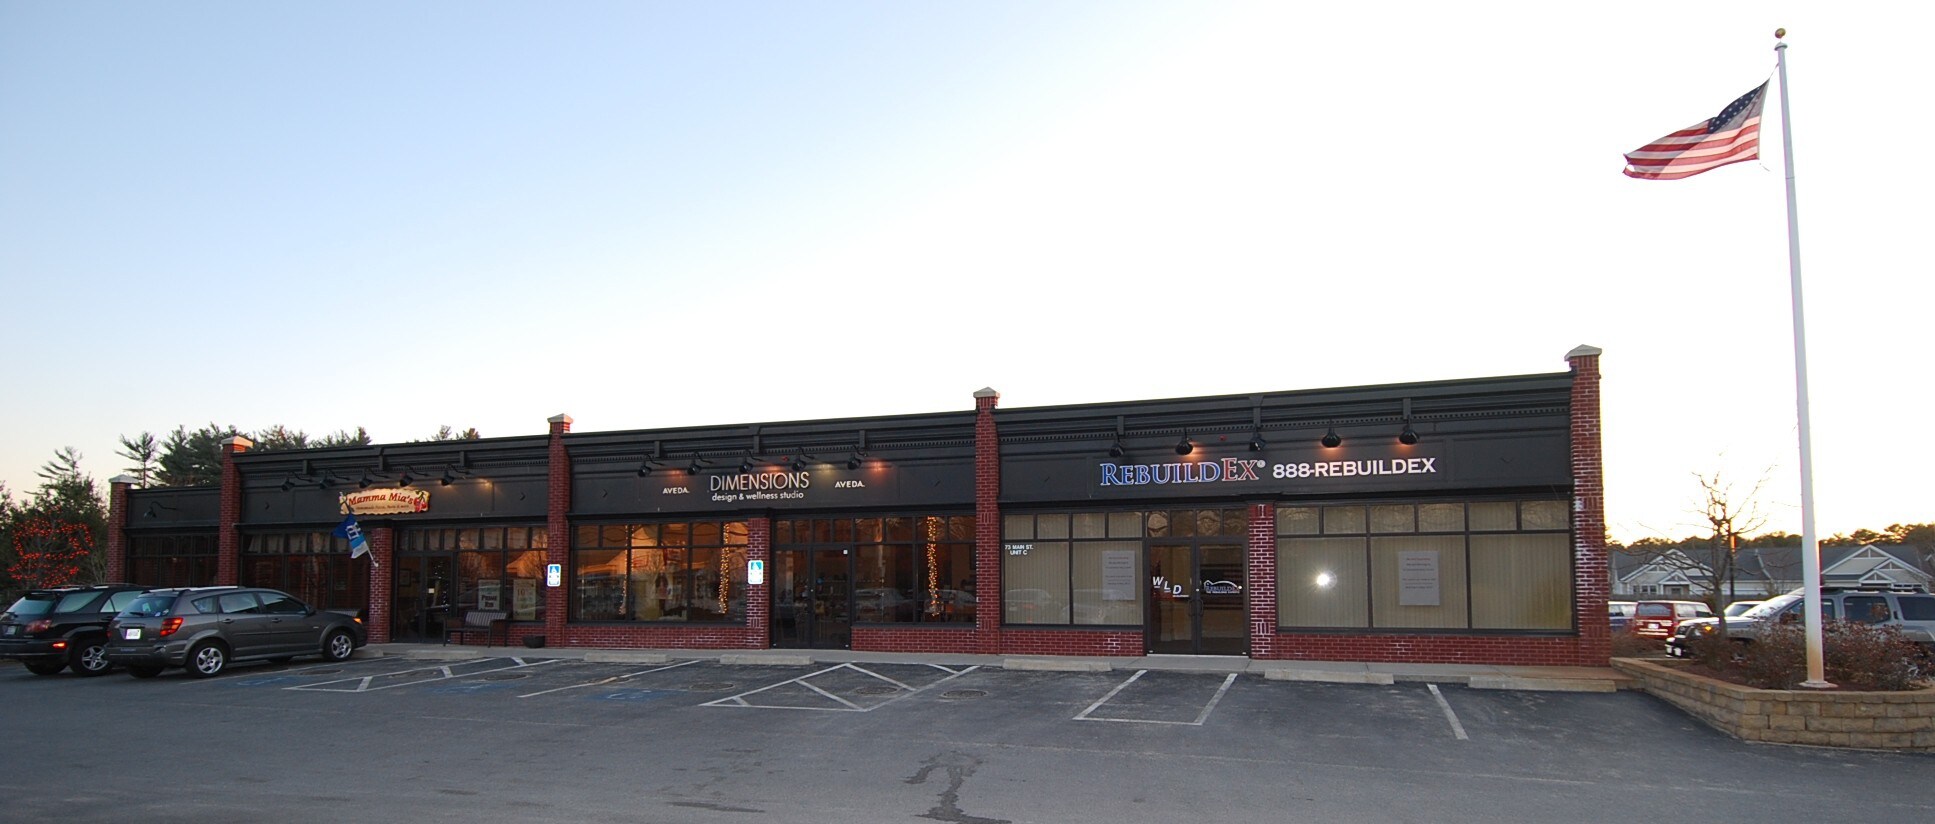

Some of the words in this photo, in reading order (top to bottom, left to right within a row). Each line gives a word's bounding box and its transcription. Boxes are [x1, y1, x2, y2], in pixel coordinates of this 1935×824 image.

[1272, 457, 1436, 479] 888-REBUILDEX
[710, 471, 810, 492] DIMENSIONS
[348, 494, 386, 506] Mamma
[388, 492, 414, 505] Mia's
[711, 492, 738, 503] design
[738, 492, 745, 501] &
[746, 491, 778, 501] wellness
[779, 490, 804, 500] studio
